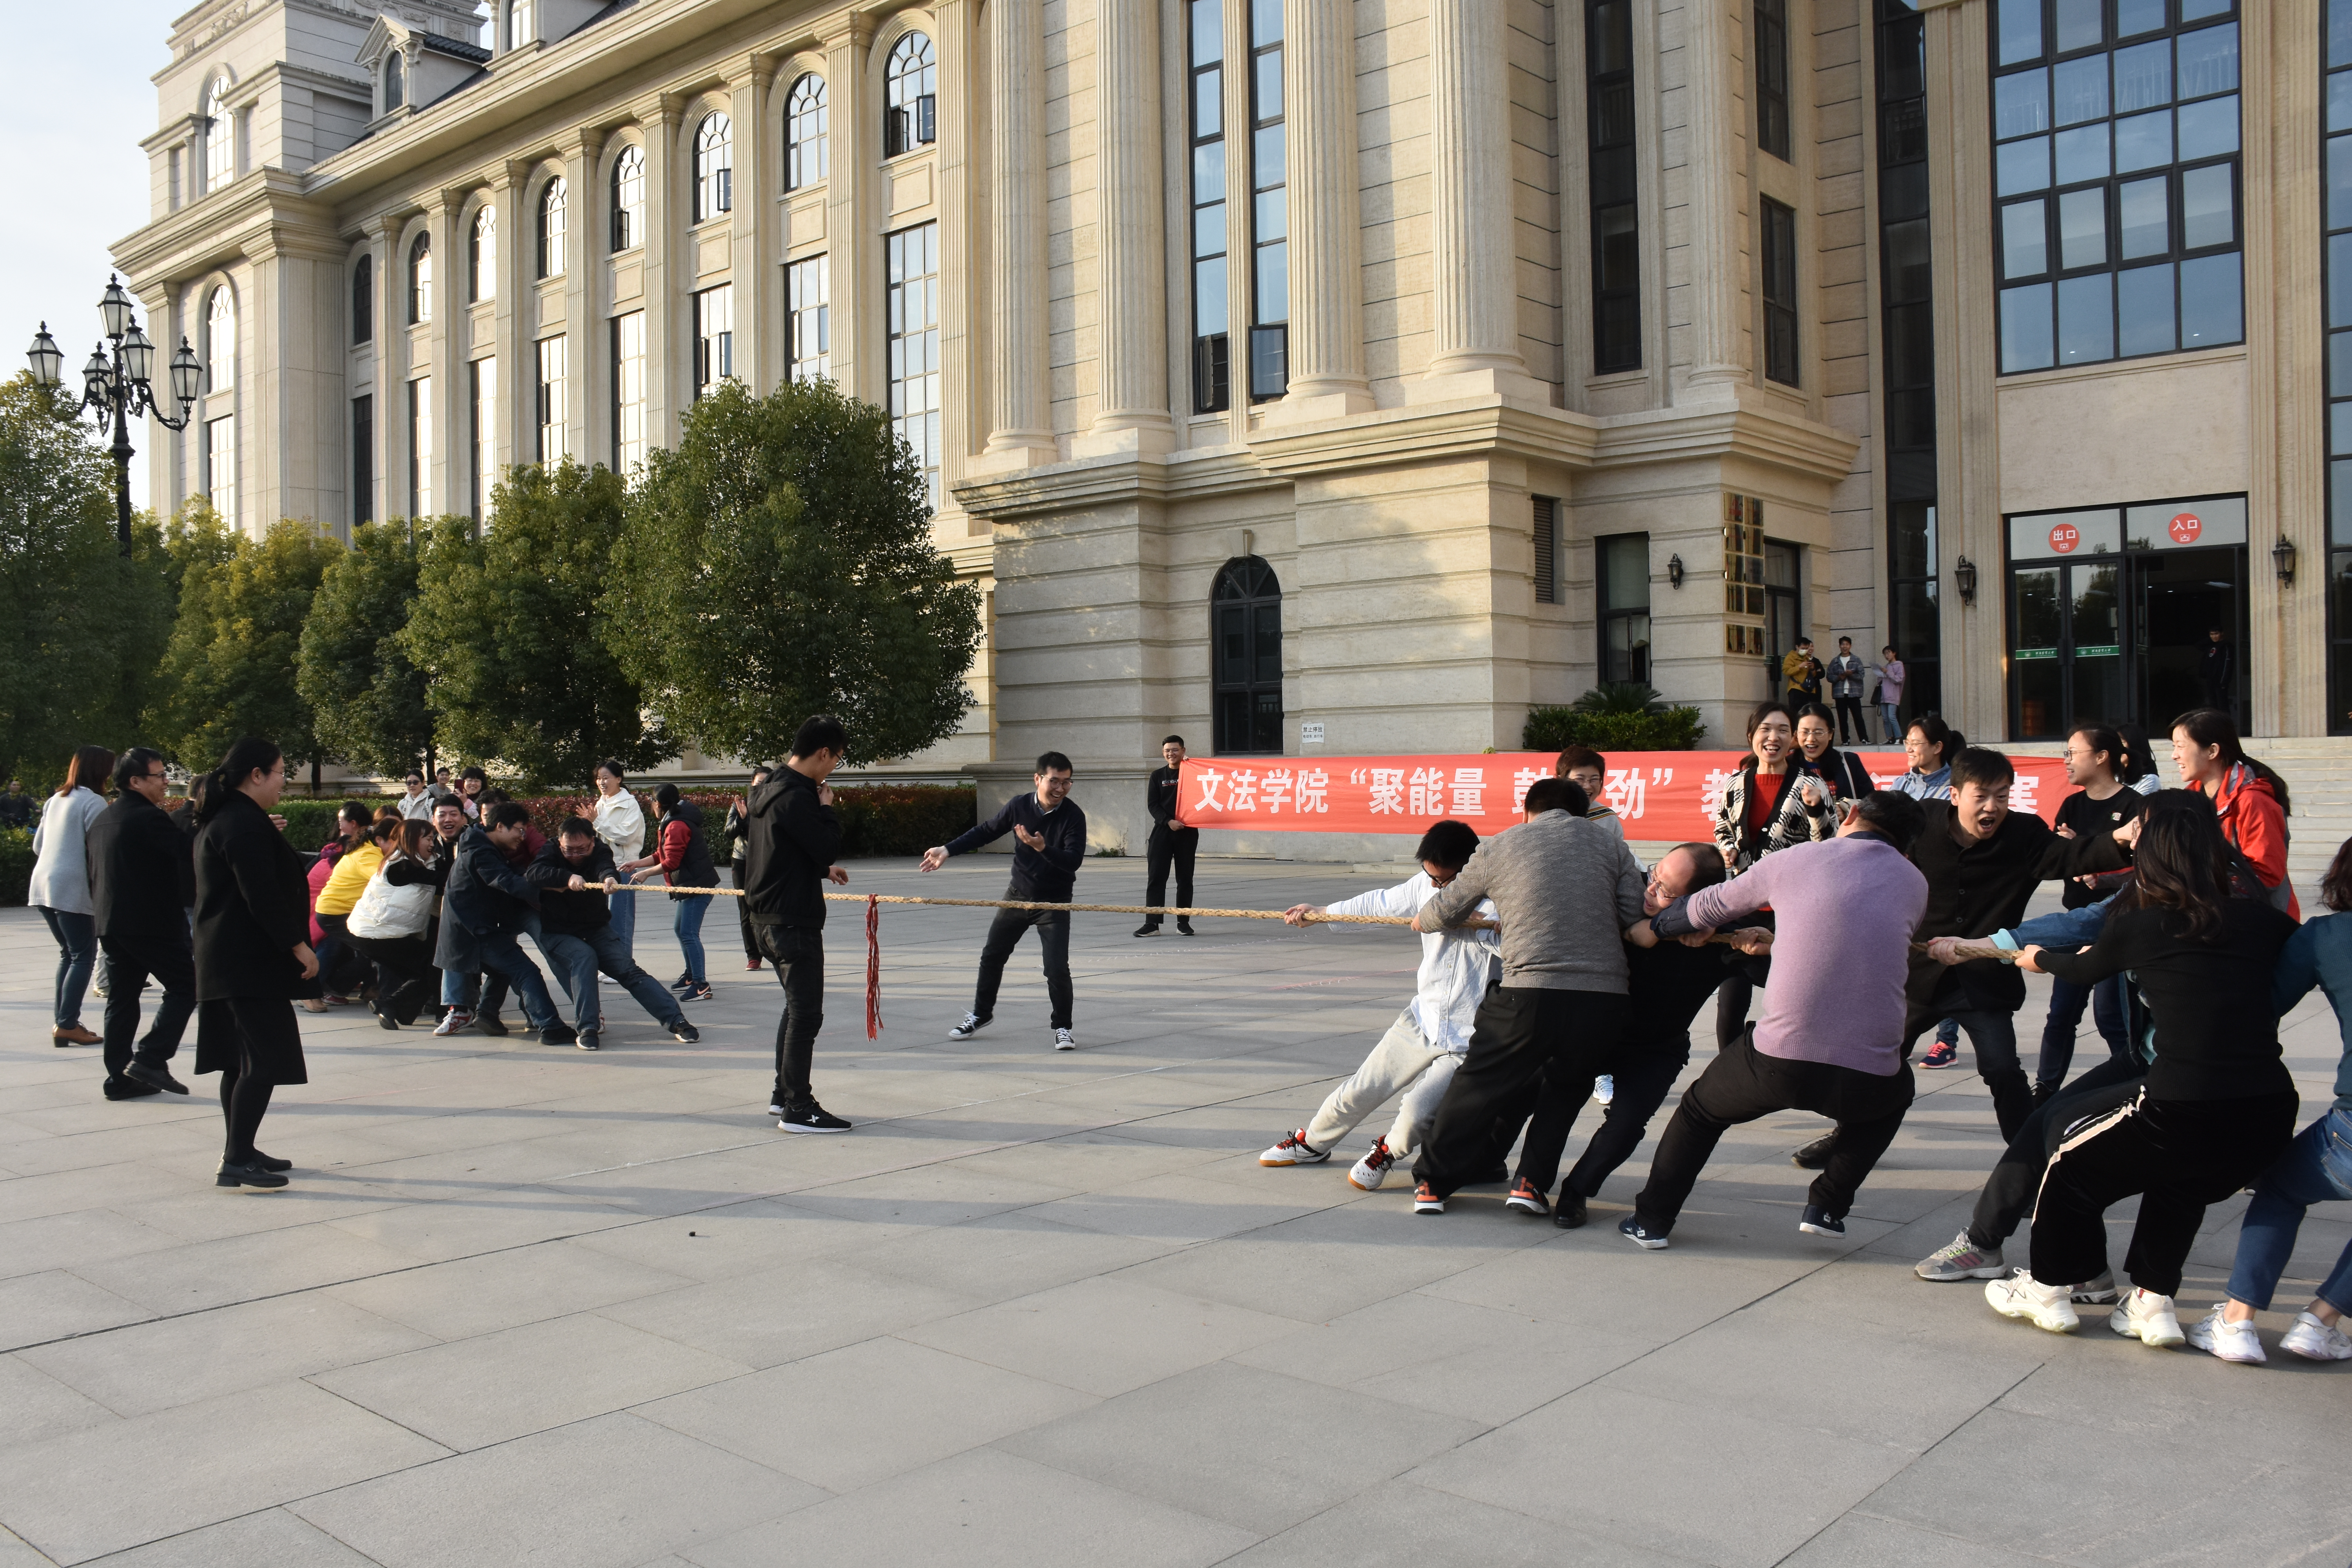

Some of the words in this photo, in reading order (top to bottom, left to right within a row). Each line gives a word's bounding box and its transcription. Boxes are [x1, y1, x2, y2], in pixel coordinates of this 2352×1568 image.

[2173, 519, 2198, 531] 入口
[2053, 530, 2075, 541] 出口
[1194, 768, 1329, 813] 文法学院
